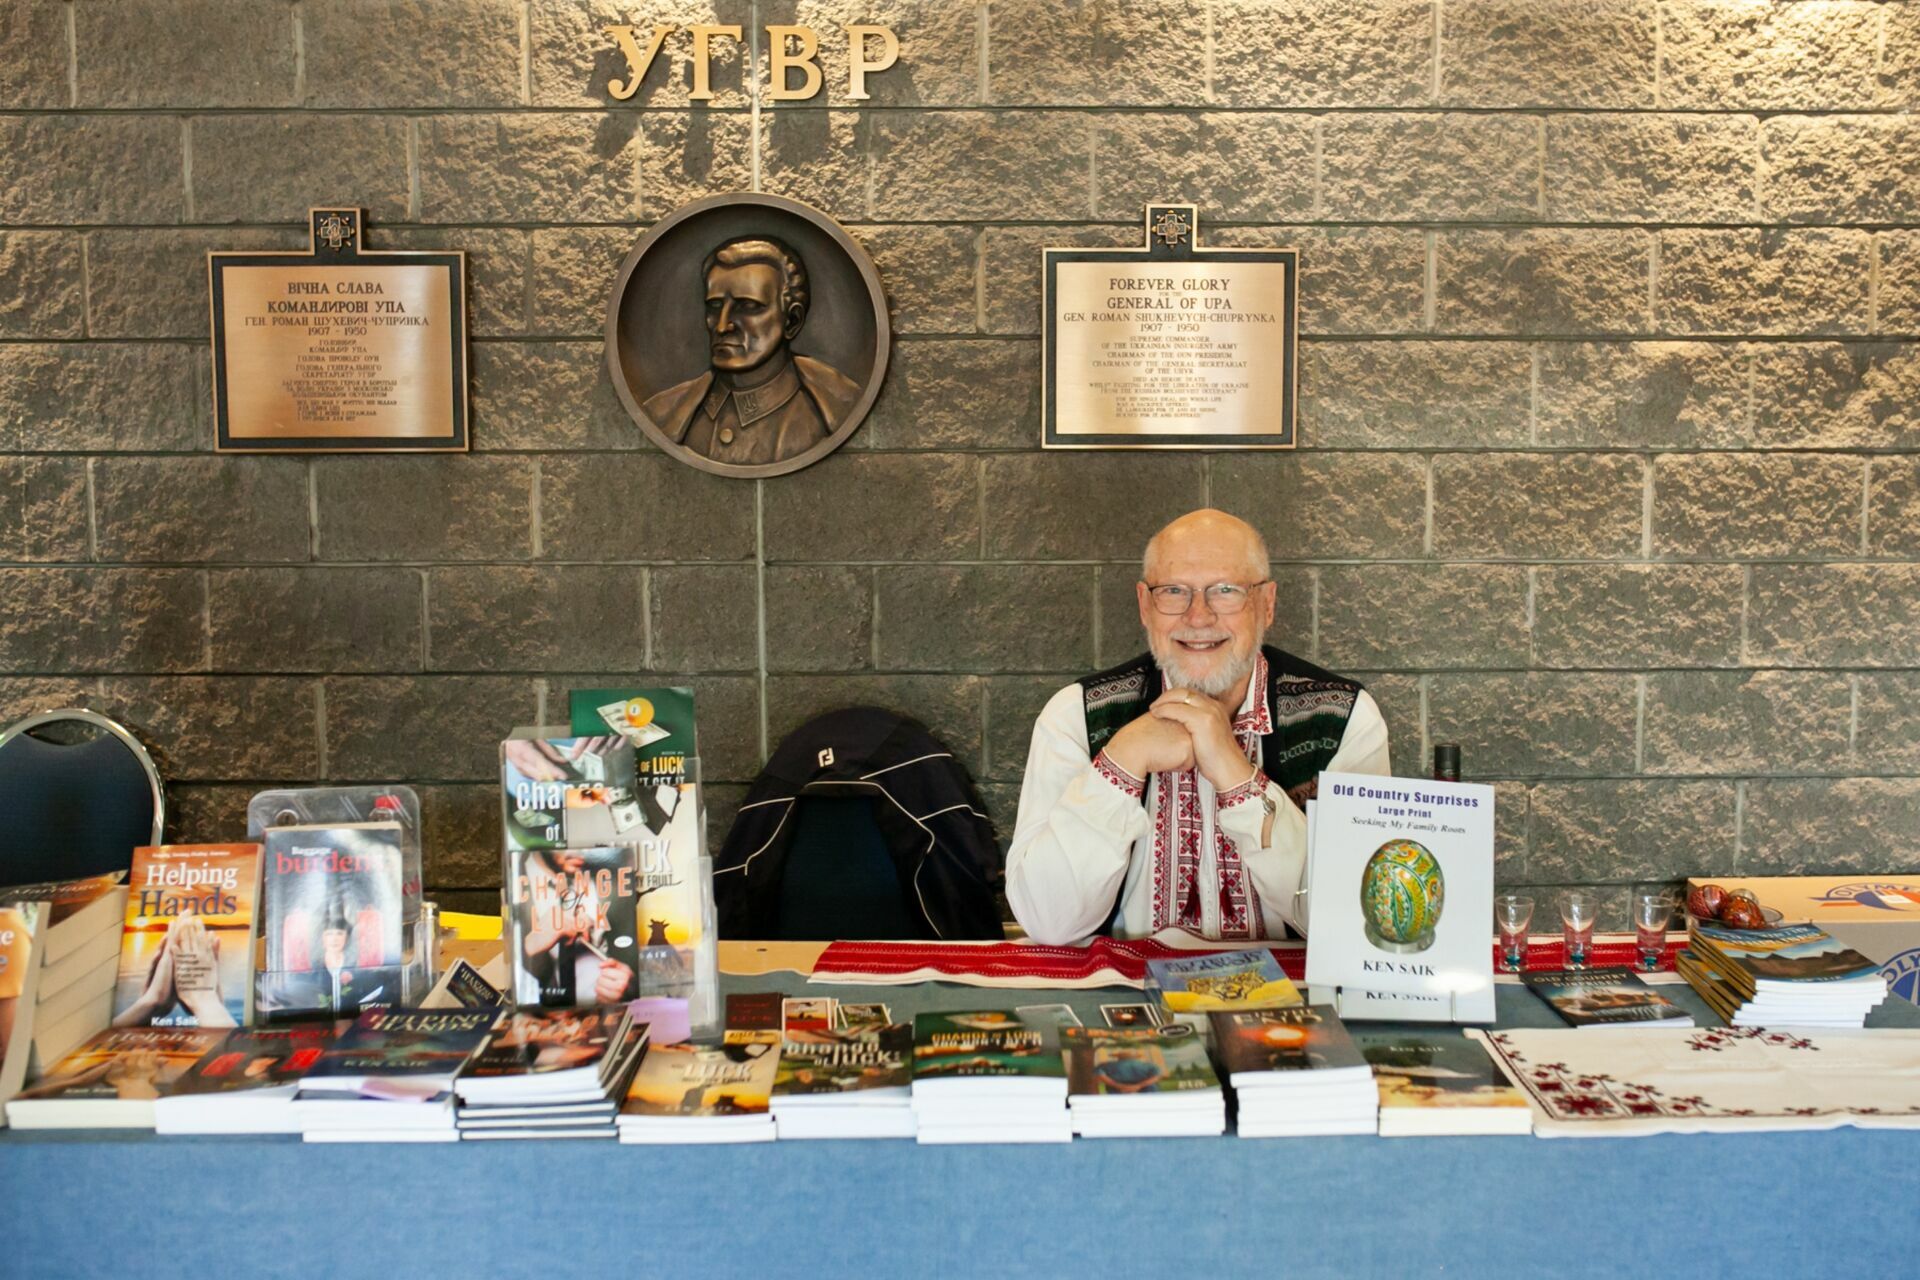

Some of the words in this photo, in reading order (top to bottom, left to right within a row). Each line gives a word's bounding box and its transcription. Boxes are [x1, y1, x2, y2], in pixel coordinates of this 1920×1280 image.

[605, 25, 900, 100] УГВР
[287, 282, 330, 295] ВІЧНА
[336, 282, 384, 295] СЛАВА
[1109, 278, 1176, 291] FOREVER
[1182, 278, 1231, 291] GLORY
[267, 301, 368, 313] КОМАНДИРОВІ
[375, 301, 406, 313] УПА
[1106, 298, 1174, 310] GENERAL
[1180, 298, 1197, 310] OF
[1204, 298, 1232, 310] UPA
[272, 316, 309, 326] РОМАН
[1091, 313, 1131, 322] ROMAN
[1135, 313, 1276, 322] SHUKHEVYCH-CHUPRYNKA
[308, 326, 330, 336] 1907
[344, 326, 367, 336] 1950
[1140, 323, 1163, 332] 1907
[1176, 323, 1200, 332] 1950
[652, 756, 686, 775] LUCK
[1333, 784, 1354, 797] Old
[1358, 785, 1411, 804] Country
[1414, 791, 1479, 808] Surprises
[1378, 806, 1406, 818] Large
[1407, 807, 1432, 819] Print
[1351, 816, 1388, 829] Seeking
[1389, 819, 1404, 830] My
[1406, 821, 1438, 833] Family
[1440, 824, 1467, 835] Roots
[545, 824, 561, 843] of
[145, 861, 239, 891] Helping
[646, 874, 674, 888] FAULT
[518, 866, 634, 904] CHANGE
[137, 886, 238, 918] Hands
[531, 901, 613, 933] LUCK
[1363, 959, 1395, 974] KEN
[1399, 961, 1437, 977] SAIK
[151, 1015, 174, 1027] Ken
[175, 1014, 200, 1027] Saik
